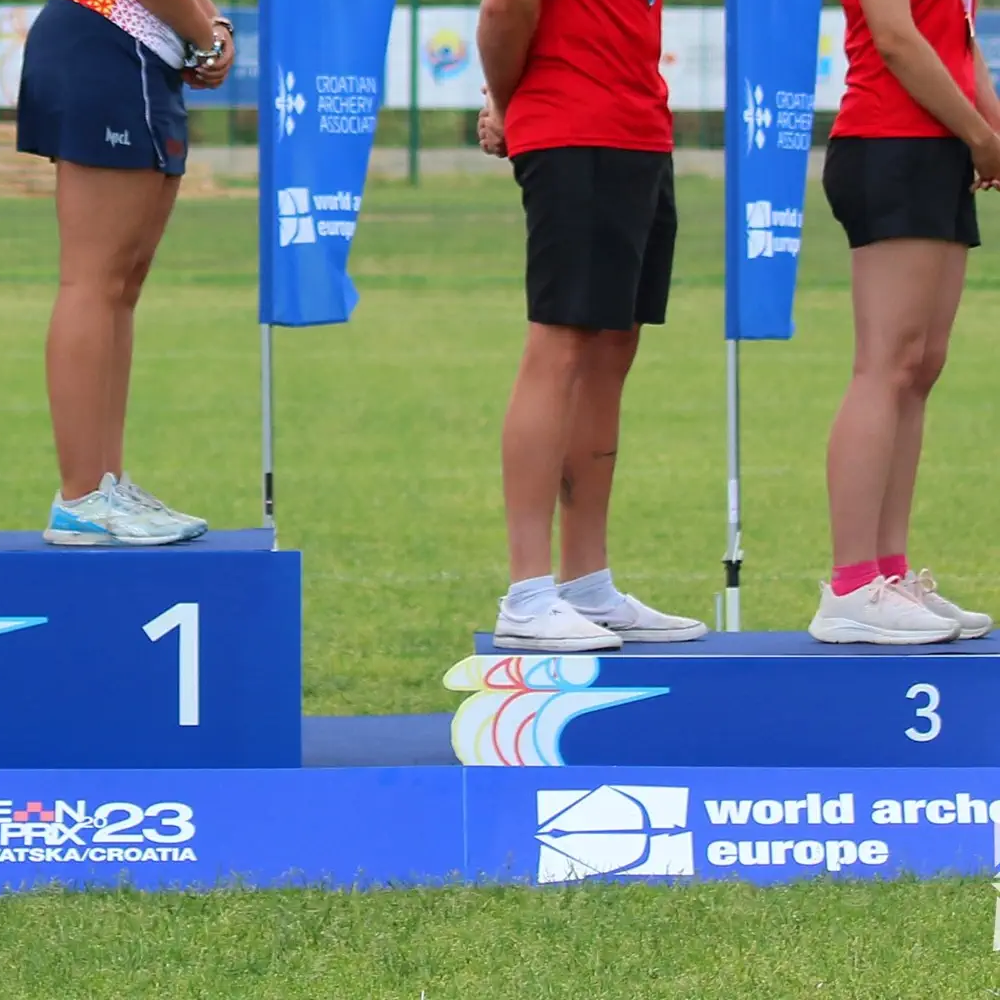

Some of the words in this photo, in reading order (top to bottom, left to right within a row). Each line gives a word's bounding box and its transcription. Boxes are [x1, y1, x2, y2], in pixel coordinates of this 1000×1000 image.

[316, 75, 377, 94] CROATIAN
[317, 95, 373, 114] ARCHERY
[142, 603, 199, 726] 1
[904, 683, 941, 742] 3
[704, 793, 854, 824] world
[0, 823, 87, 846] PRIX
[706, 839, 889, 871] europe
